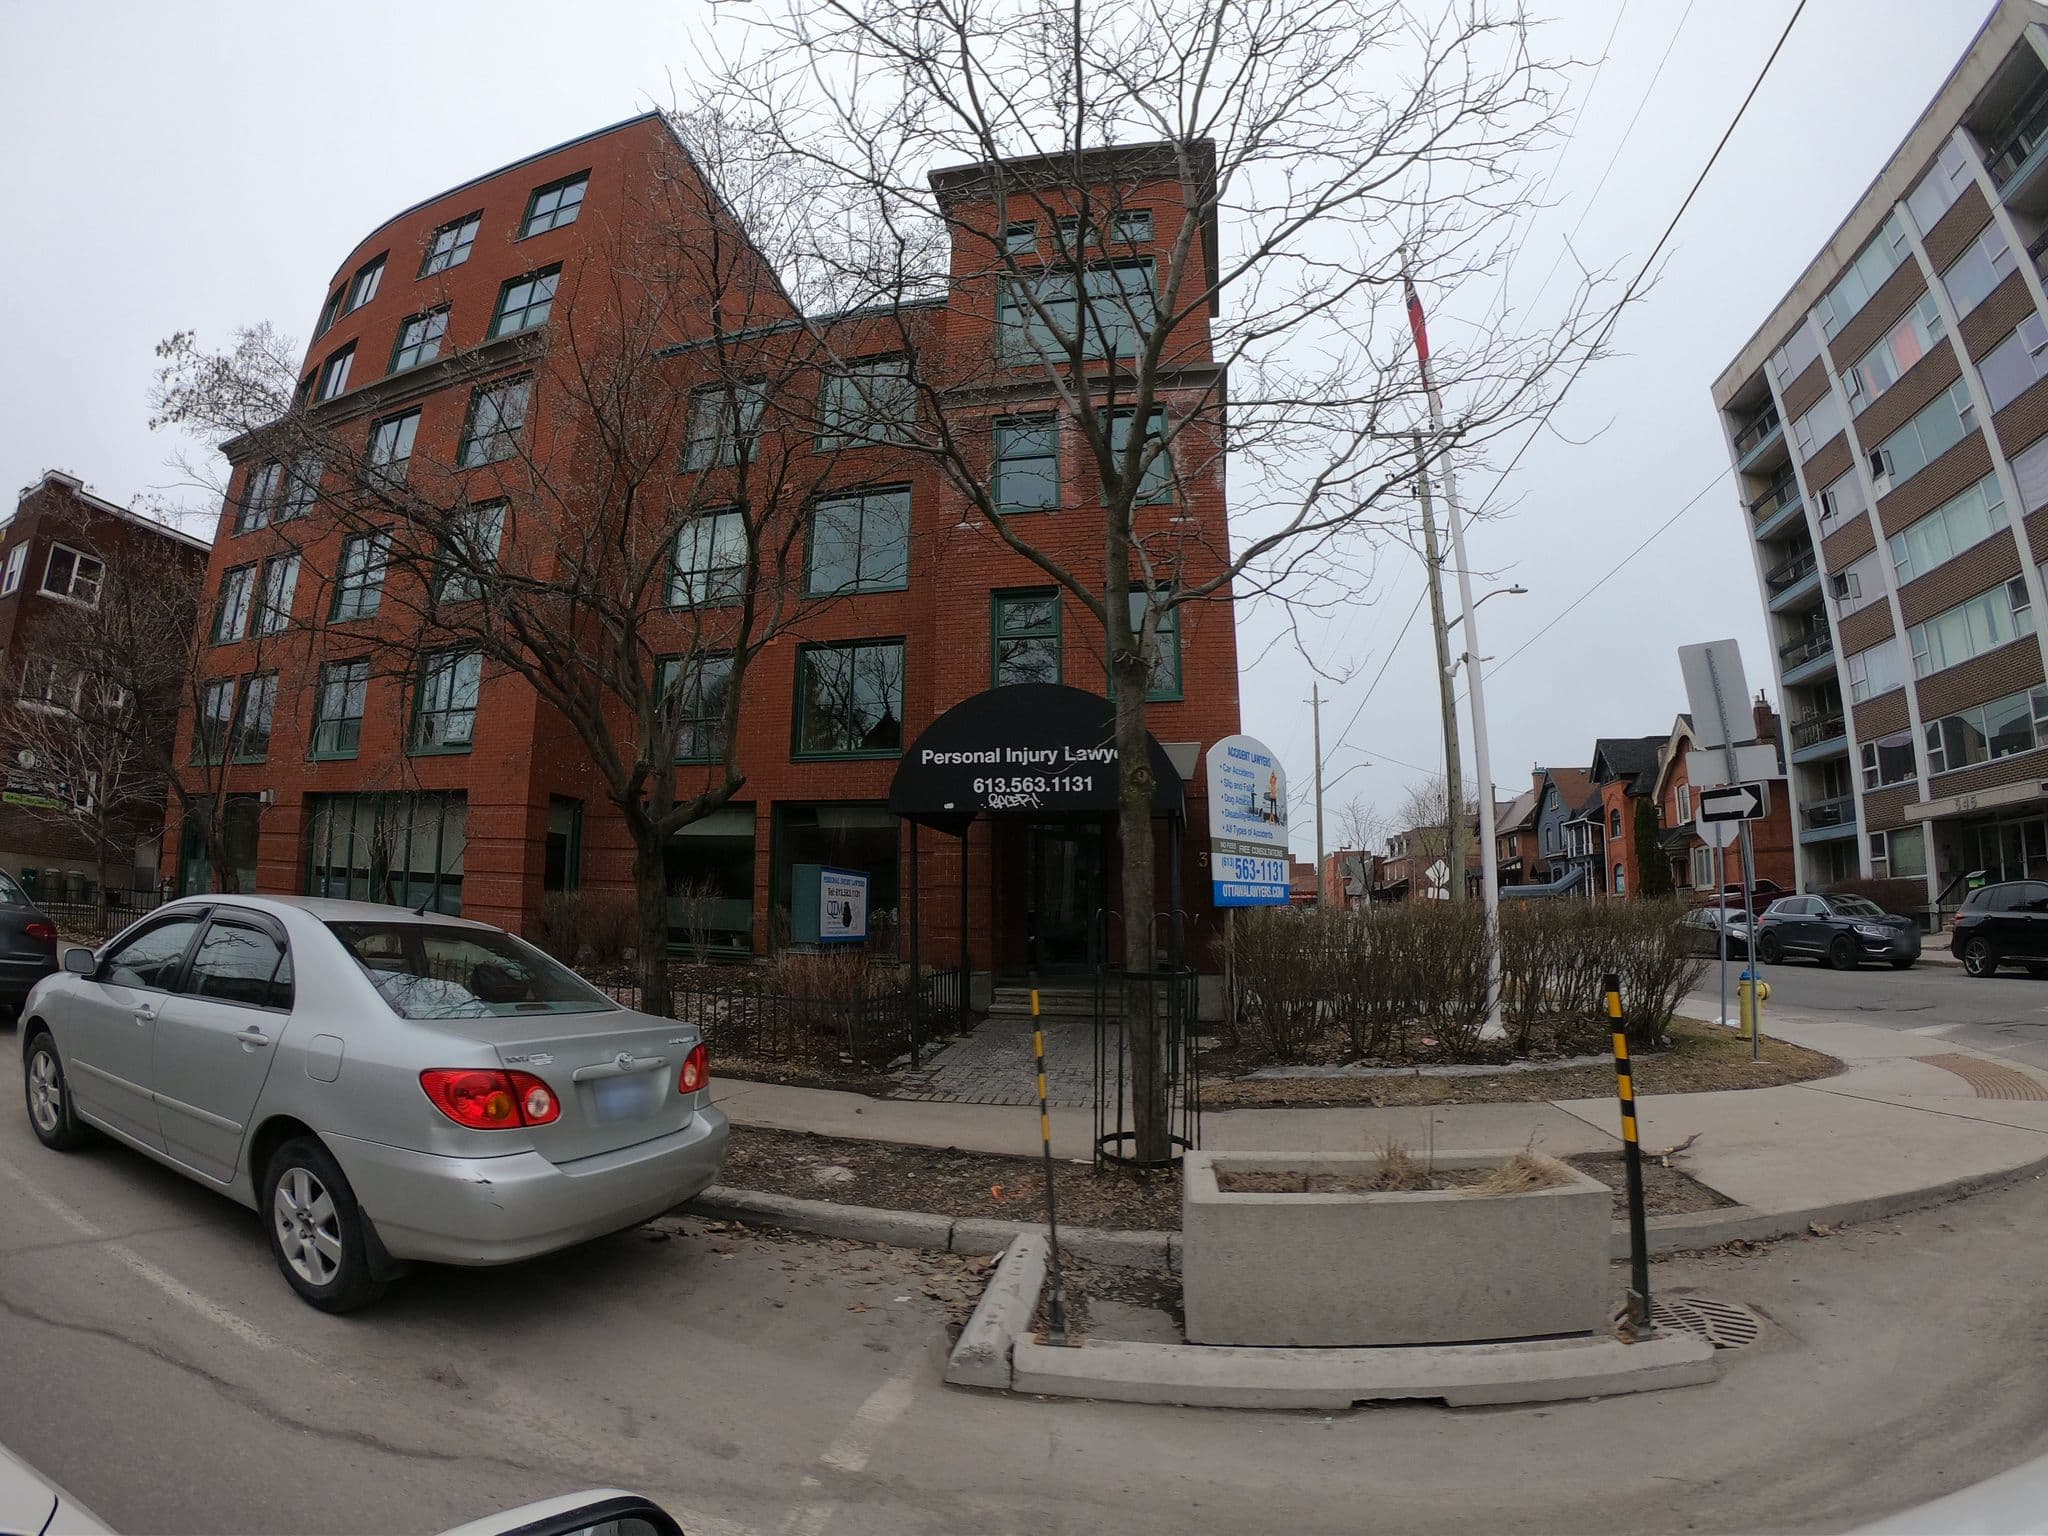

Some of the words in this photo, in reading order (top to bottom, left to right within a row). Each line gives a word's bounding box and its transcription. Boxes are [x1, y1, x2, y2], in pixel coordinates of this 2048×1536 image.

[921, 748, 1000, 764] Personal
[1006, 748, 1058, 765] Injury
[1065, 746, 1118, 764] Lawy
[1227, 746, 1250, 761] ACCIDENT
[1250, 753, 1272, 768] LAWYERS
[1222, 763, 1231, 773] Car
[1232, 766, 1255, 779] Accidents
[973, 776, 1092, 793] 613.563.1131
[1223, 779, 1233, 789] Slip
[1234, 782, 1243, 791] and
[1224, 794, 1234, 805] Dog
[1233, 825, 1247, 836] Types
[1253, 827, 1273, 839] Accidents
[1239, 845, 1251, 854] FREE
[1222, 857, 1234, 869] (613)
[1235, 858, 1283, 882] 563-1131
[1223, 884, 1284, 898] OTTAWALAWYERS.COM
